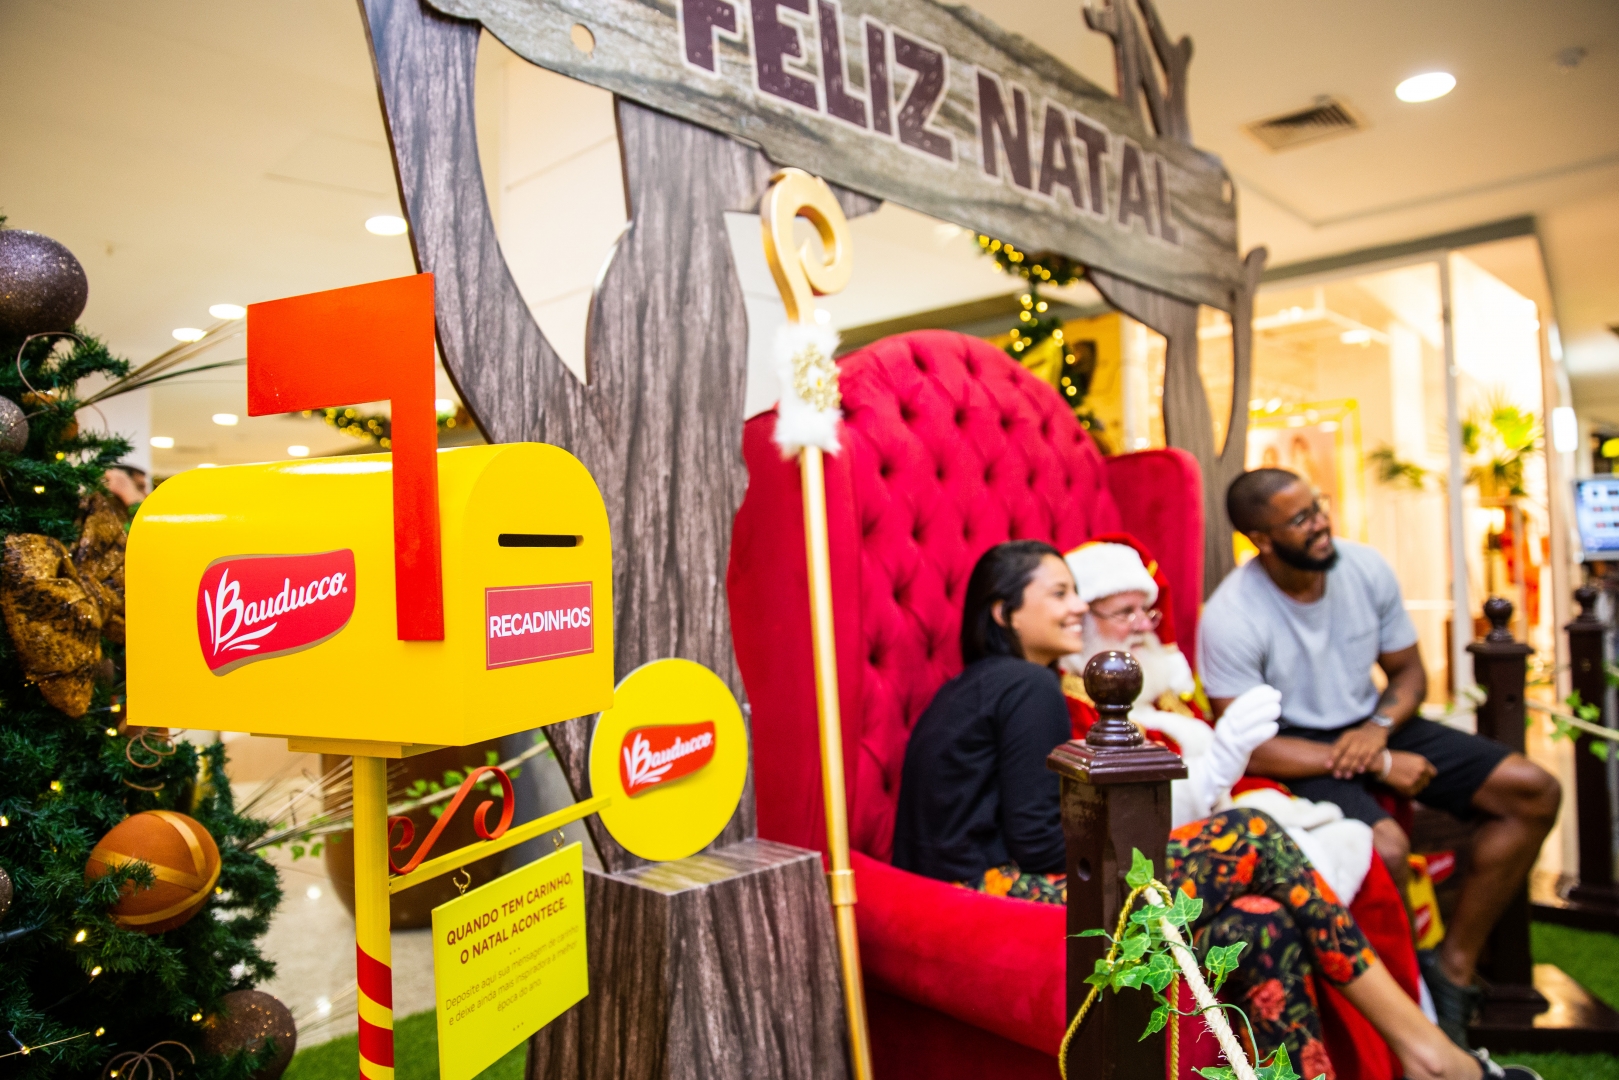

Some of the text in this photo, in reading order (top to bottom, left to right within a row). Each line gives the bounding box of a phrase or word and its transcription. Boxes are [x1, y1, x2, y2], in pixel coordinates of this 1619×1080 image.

[679, 0, 1183, 248] FELIZ NATAL
[204, 568, 347, 656] Bauducco
[489, 606, 591, 639] RECADINHOS
[623, 732, 713, 788] Bauducco
[446, 872, 573, 946] QUANDO TEM CARINHO,
[460, 897, 567, 965] O NATAL ACONTECE.
[446, 984, 480, 1011] Deposite
[481, 971, 497, 989] aqui
[498, 965, 510, 979] sua
[512, 944, 547, 970] mensagem
[548, 938, 556, 949] de
[448, 1016, 454, 1026] e
[455, 1003, 475, 1022] deixe
[476, 990, 497, 1009] ainda
[497, 979, 514, 996] mais
[515, 956, 551, 984] inspiradora
[552, 953, 556, 962] a
[497, 993, 518, 1012] época
[519, 986, 528, 998] do
